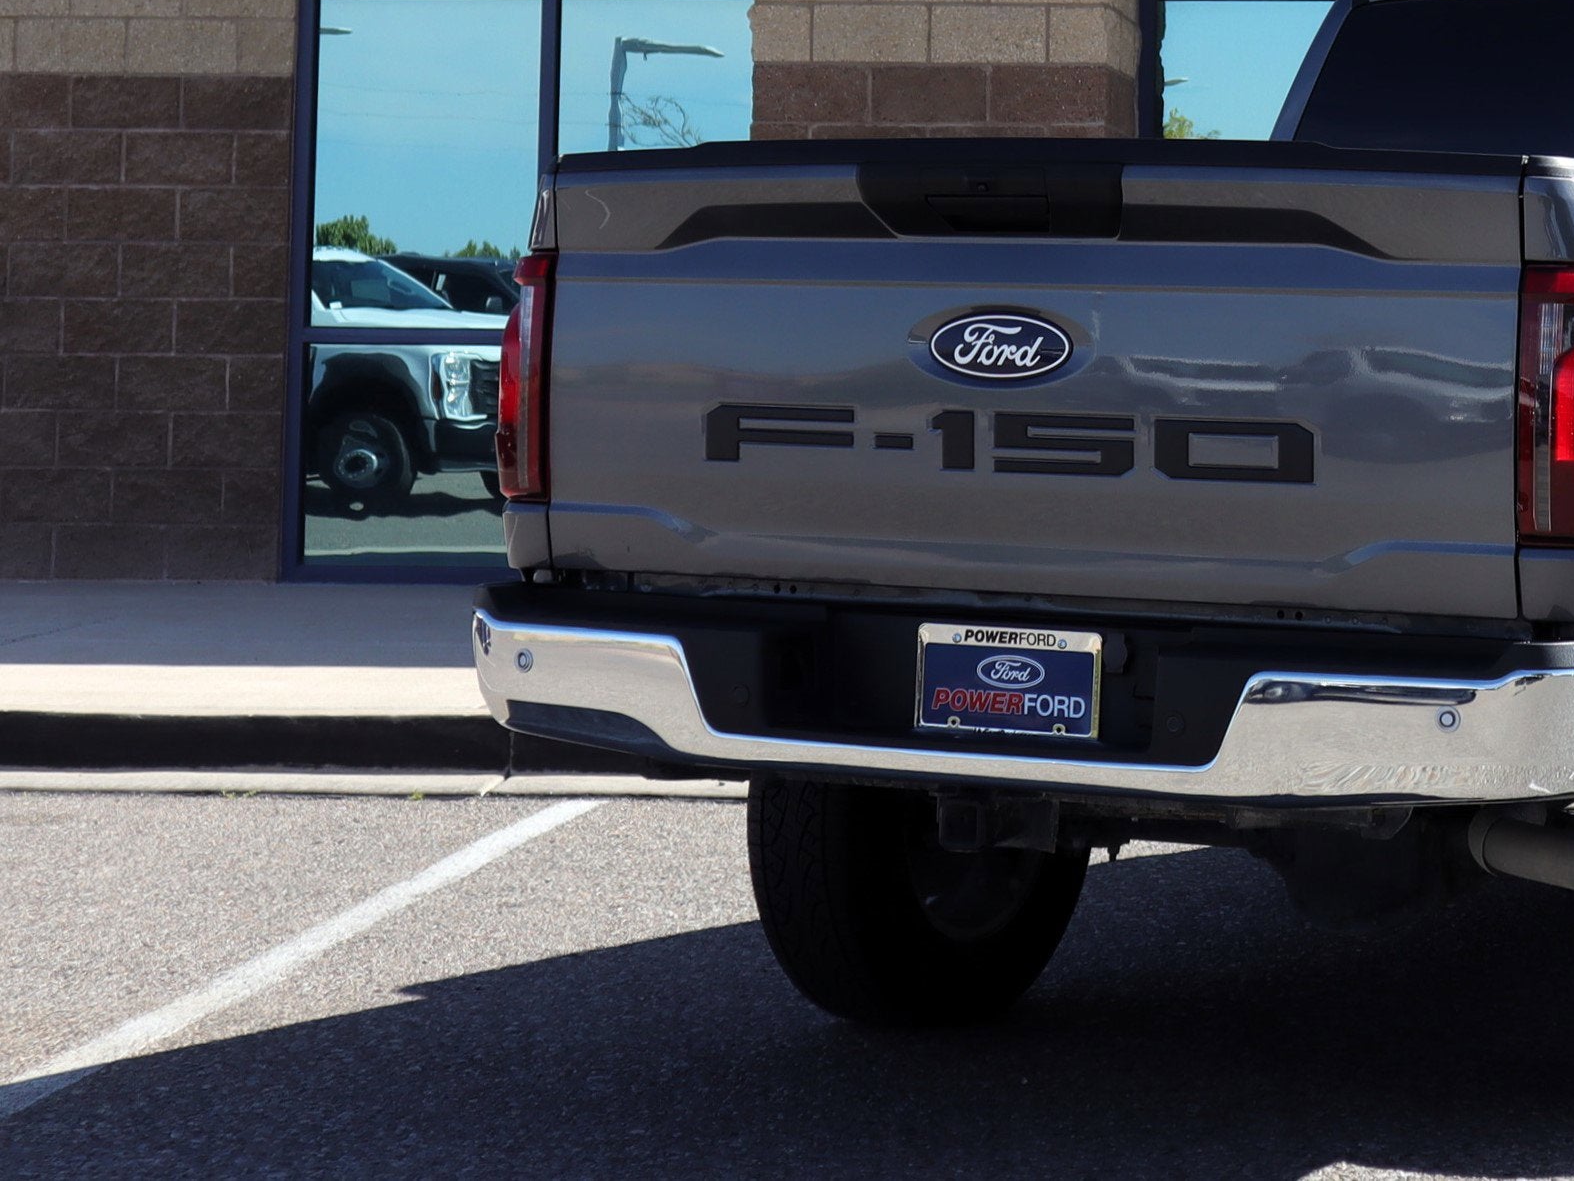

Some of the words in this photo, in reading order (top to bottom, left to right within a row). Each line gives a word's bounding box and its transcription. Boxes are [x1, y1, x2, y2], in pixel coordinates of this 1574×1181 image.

[954, 324, 1043, 369] Ford
[704, 404, 1316, 484] F-150
[964, 629, 1056, 647] POWERFORD
[991, 660, 1030, 682] Ford
[931, 687, 1086, 718] POWERFORD
